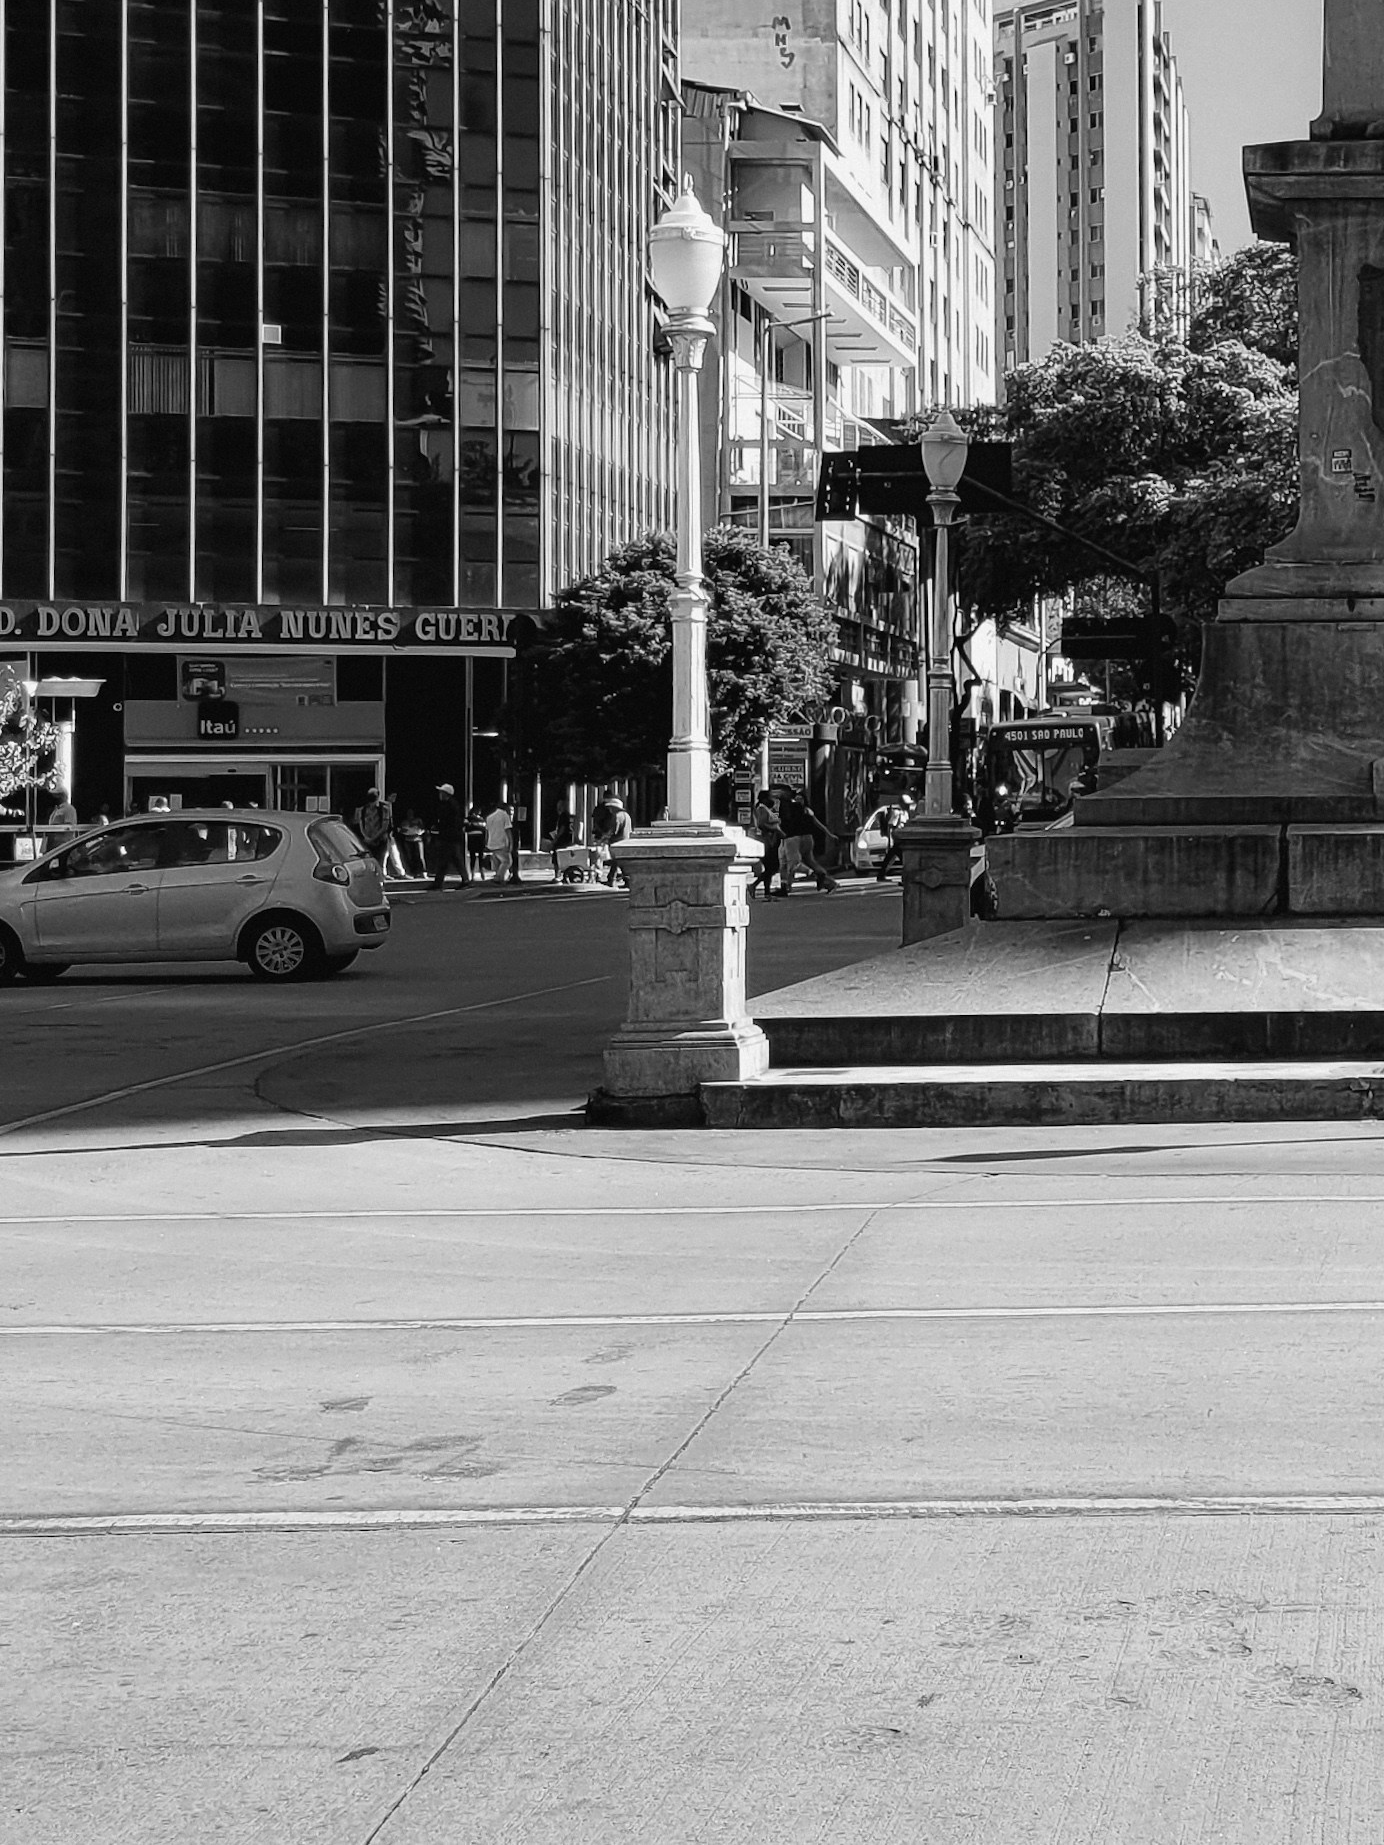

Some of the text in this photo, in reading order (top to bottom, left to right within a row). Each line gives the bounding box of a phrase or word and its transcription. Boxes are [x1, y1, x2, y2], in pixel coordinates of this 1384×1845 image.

[37, 607, 138, 637] DONA
[157, 608, 262, 638] JULIA
[279, 610, 400, 641] NUNES
[415, 612, 541, 642] GUER
[200, 719, 236, 735] Itaú
[1004, 730, 1028, 741] 4501
[1053, 727, 1084, 739] PAULO
